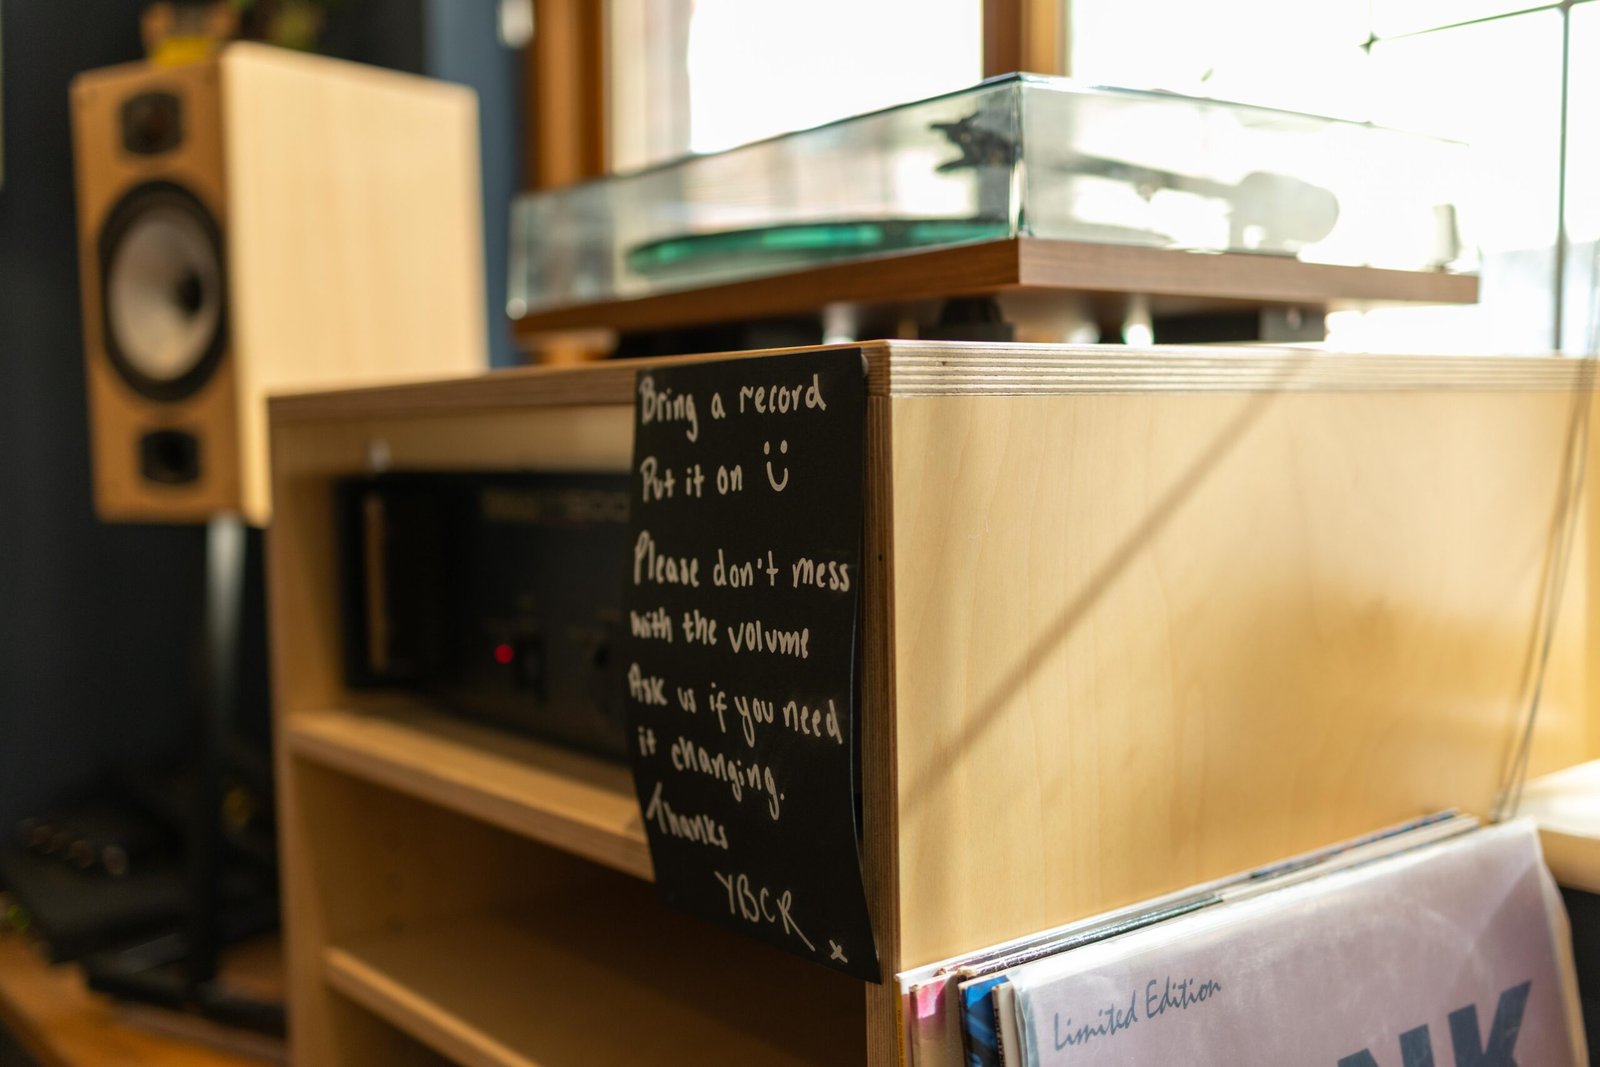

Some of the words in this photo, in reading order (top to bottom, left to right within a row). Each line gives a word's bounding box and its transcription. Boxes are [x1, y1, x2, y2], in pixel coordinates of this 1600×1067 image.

[639, 376, 698, 443] Bring
[711, 392, 726, 419] a
[740, 373, 826, 414] record
[640, 456, 675, 502] Put
[686, 464, 704, 497] it
[717, 465, 742, 495] on
[634, 530, 699, 587] Please
[713, 548, 778, 587] don't
[792, 557, 849, 592] mess
[630, 606, 672, 643] with
[682, 608, 717, 645] the
[728, 620, 809, 658] volume
[628, 662, 667, 706] Ask
[677, 687, 697, 714] us
[709, 682, 728, 733] if
[734, 696, 773, 748] you
[783, 700, 843, 745] need
[638, 726, 656, 757] it
[671, 736, 785, 821] changing.
[646, 781, 728, 850] Thanks
[714, 871, 816, 952] YBCR
[1054, 990, 1138, 1051] Limited
[1146, 973, 1222, 1019] Edition
